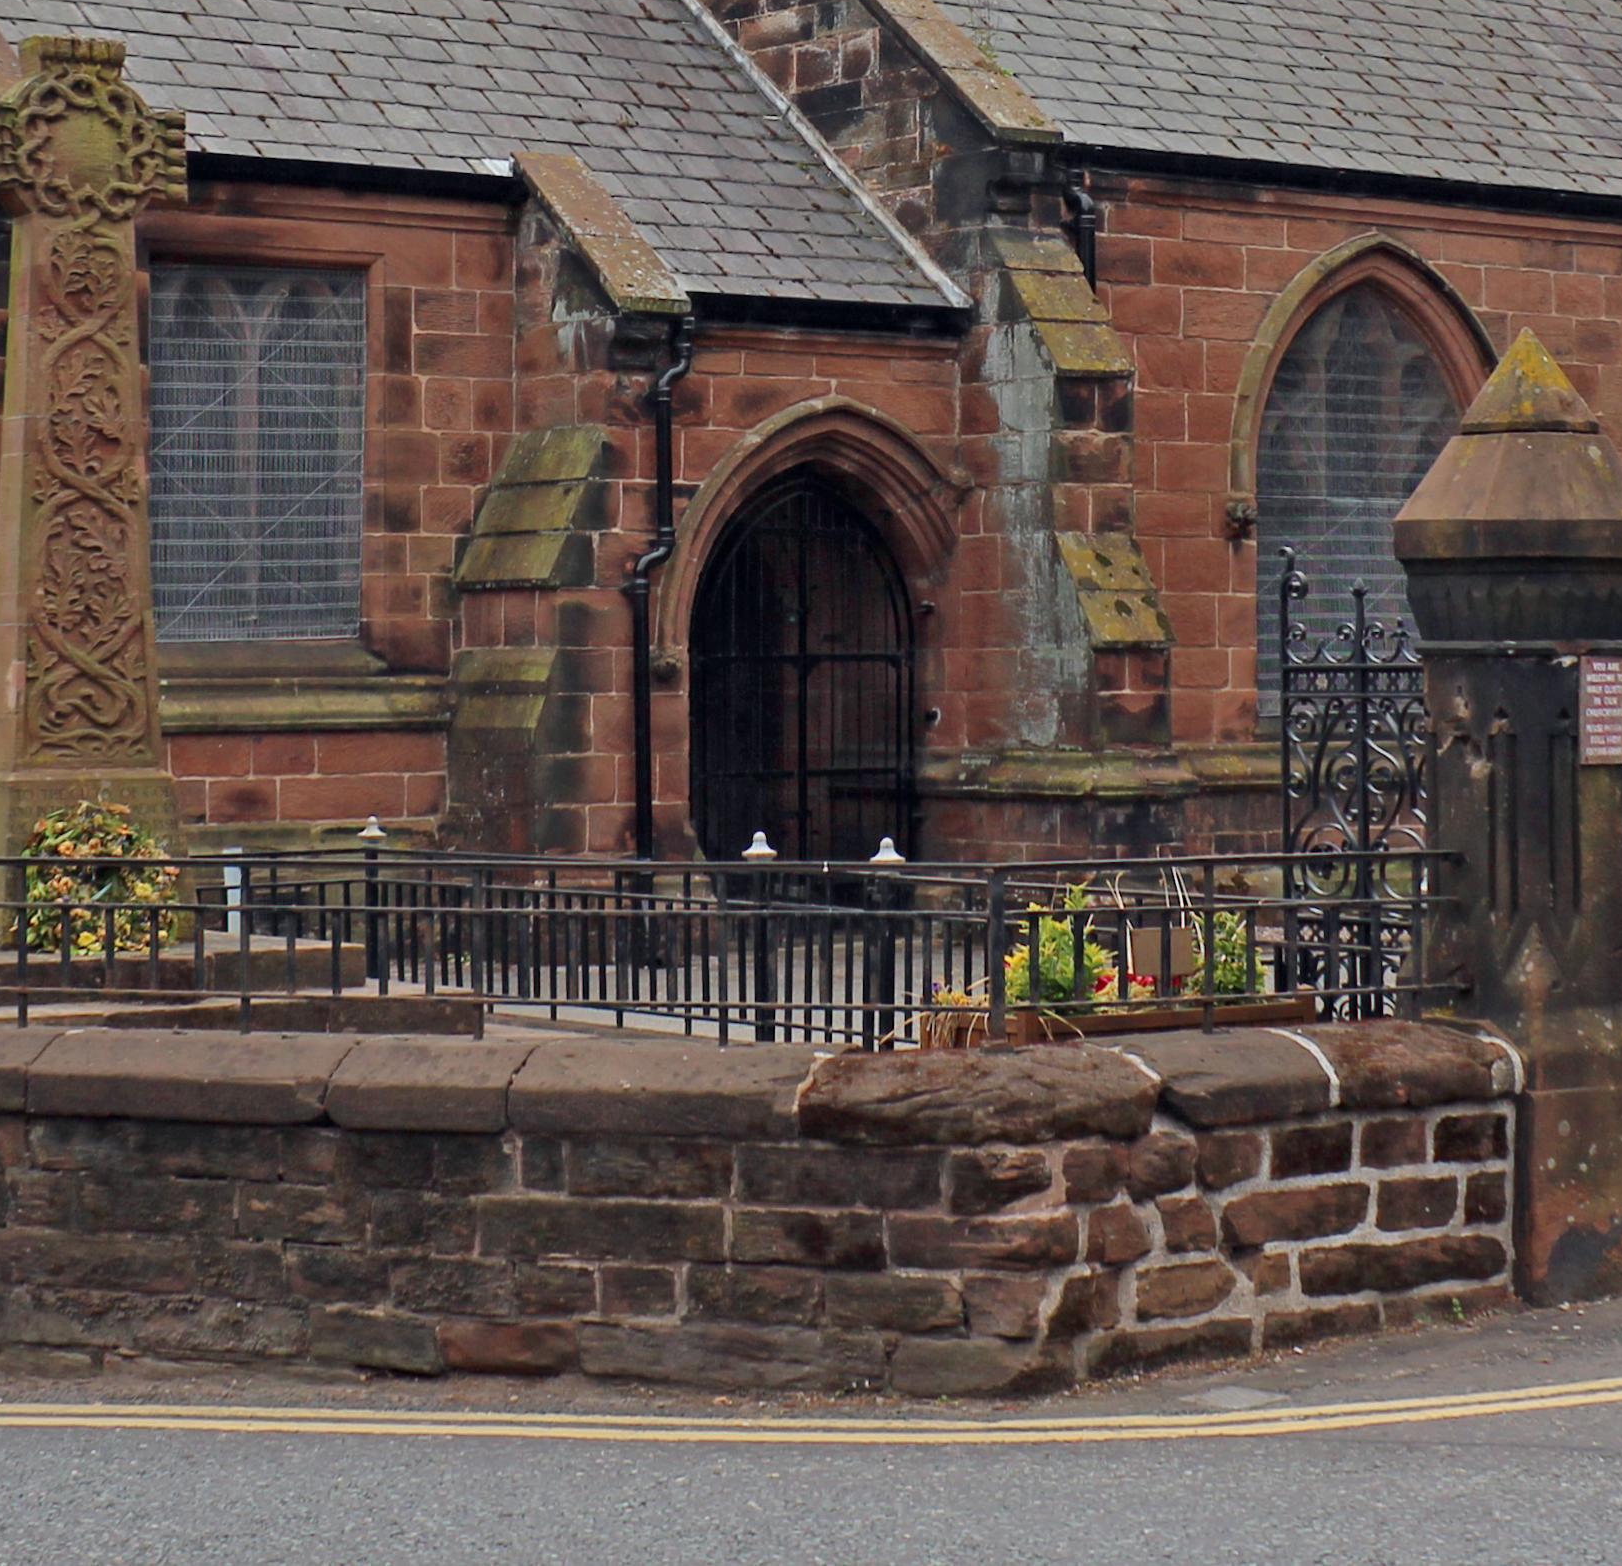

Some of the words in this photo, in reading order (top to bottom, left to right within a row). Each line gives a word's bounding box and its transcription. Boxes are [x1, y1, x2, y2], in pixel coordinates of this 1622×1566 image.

[1593, 662, 1606, 671] YOU
[1608, 662, 1620, 671] ARE
[1586, 674, 1615, 682] WELCOME
[1594, 696, 1601, 705] IN
[1603, 696, 1618, 705] OUR
